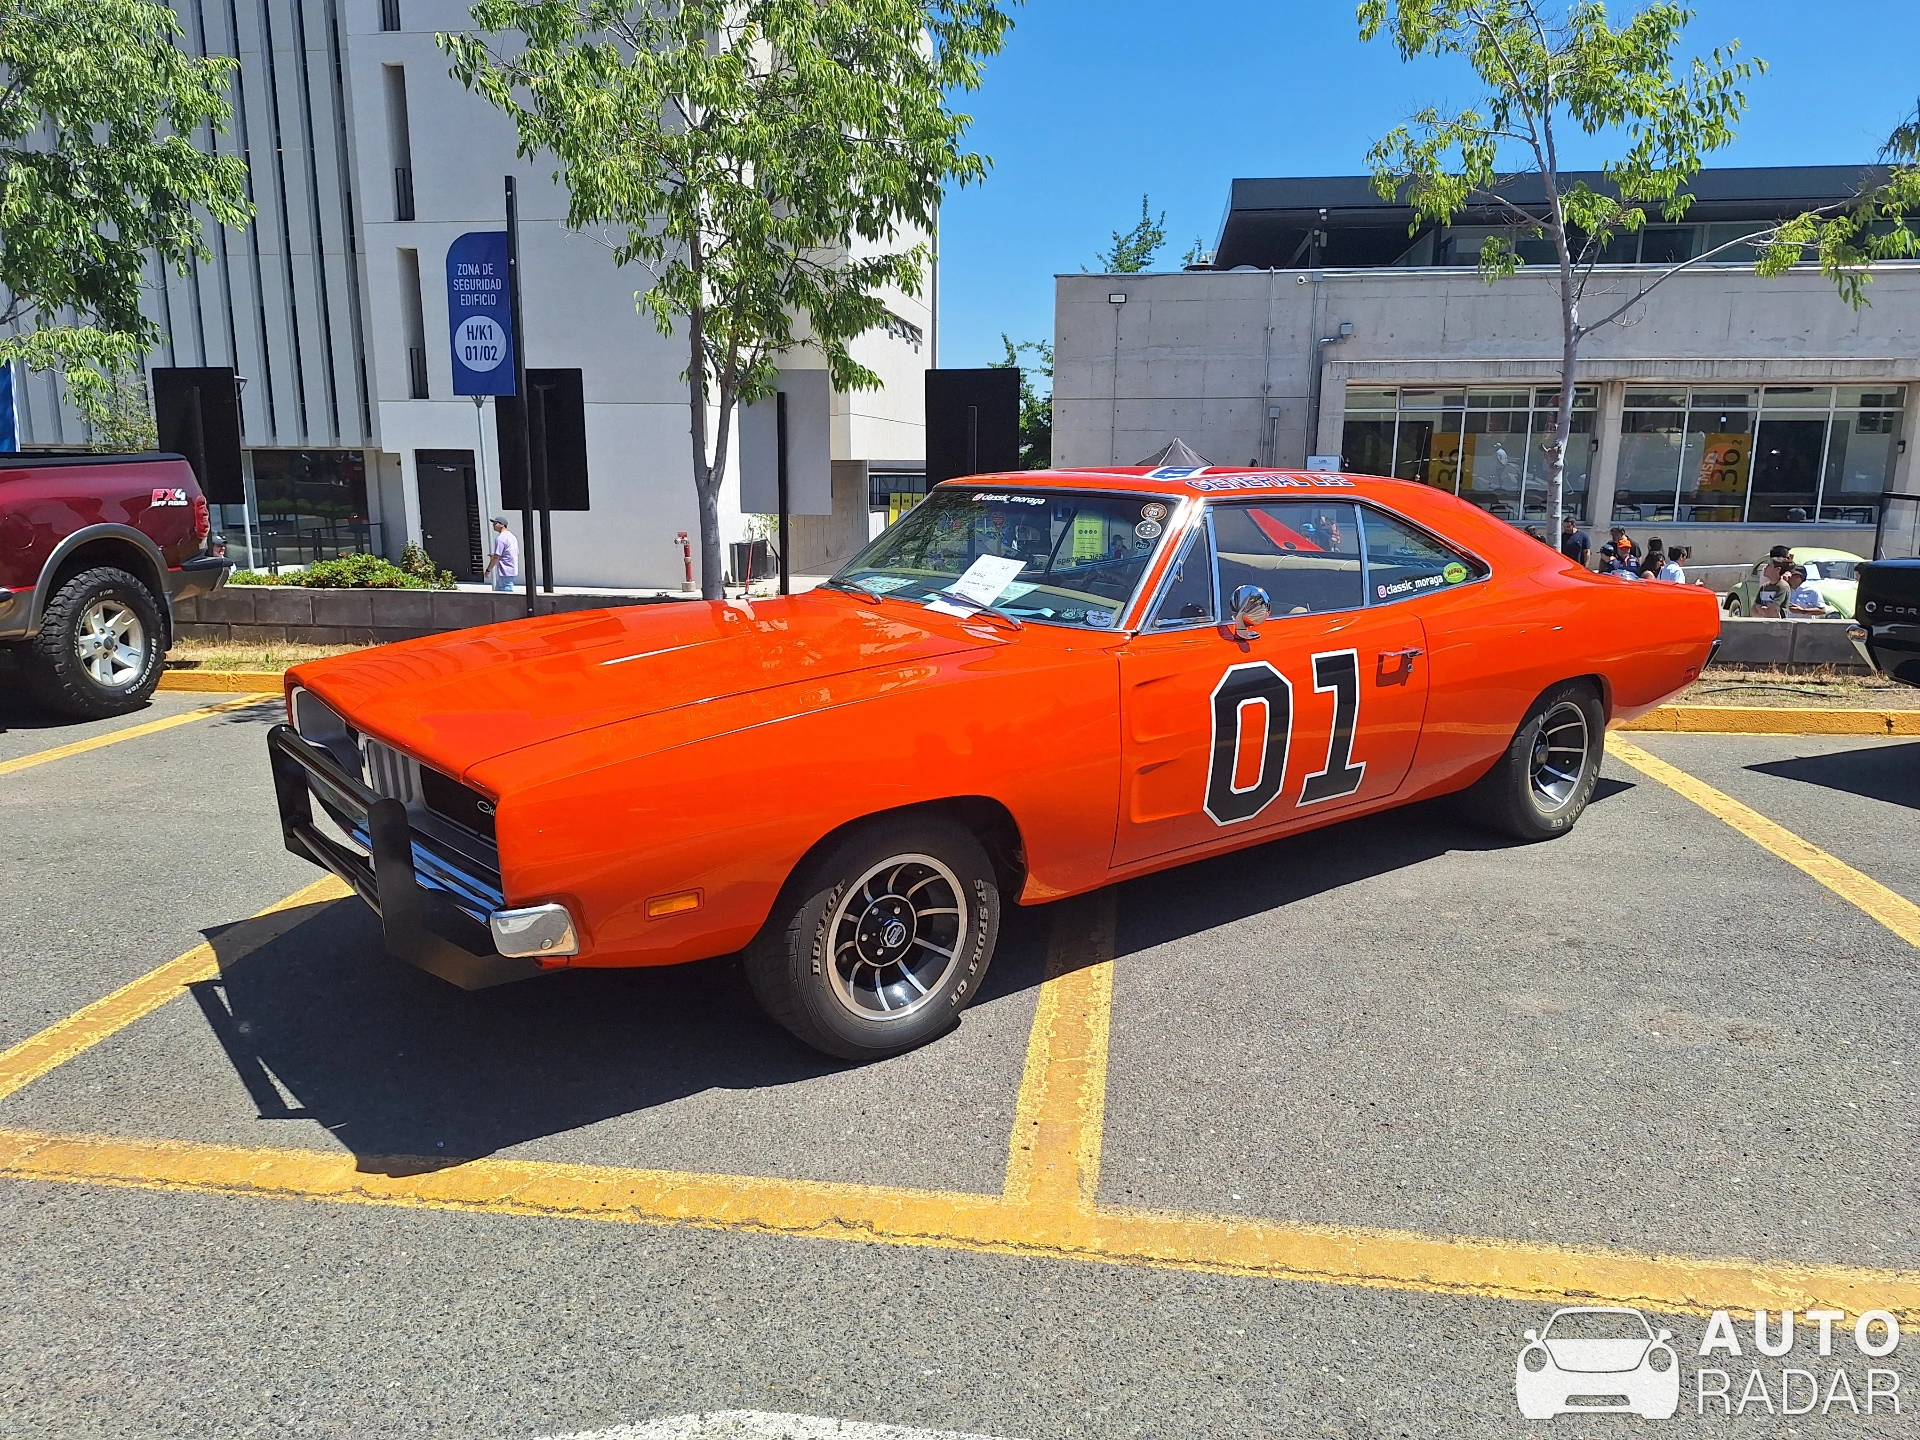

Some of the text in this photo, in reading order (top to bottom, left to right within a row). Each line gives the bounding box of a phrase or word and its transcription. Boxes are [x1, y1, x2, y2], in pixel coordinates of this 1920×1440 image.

[457, 263, 494, 275] ZONA DE
[453, 278, 502, 291] SEGURIDAD
[460, 293, 497, 306] EDIFICIO
[466, 324, 493, 340] H/K1
[465, 345, 498, 361] 01/02
[1185, 474, 1355, 492] GENERAL LEE
[152, 488, 186, 501] FX4
[1203, 647, 1367, 827] 01
[811, 878, 846, 976] DUNLOP
[951, 878, 990, 1007] SP SPORT GT
